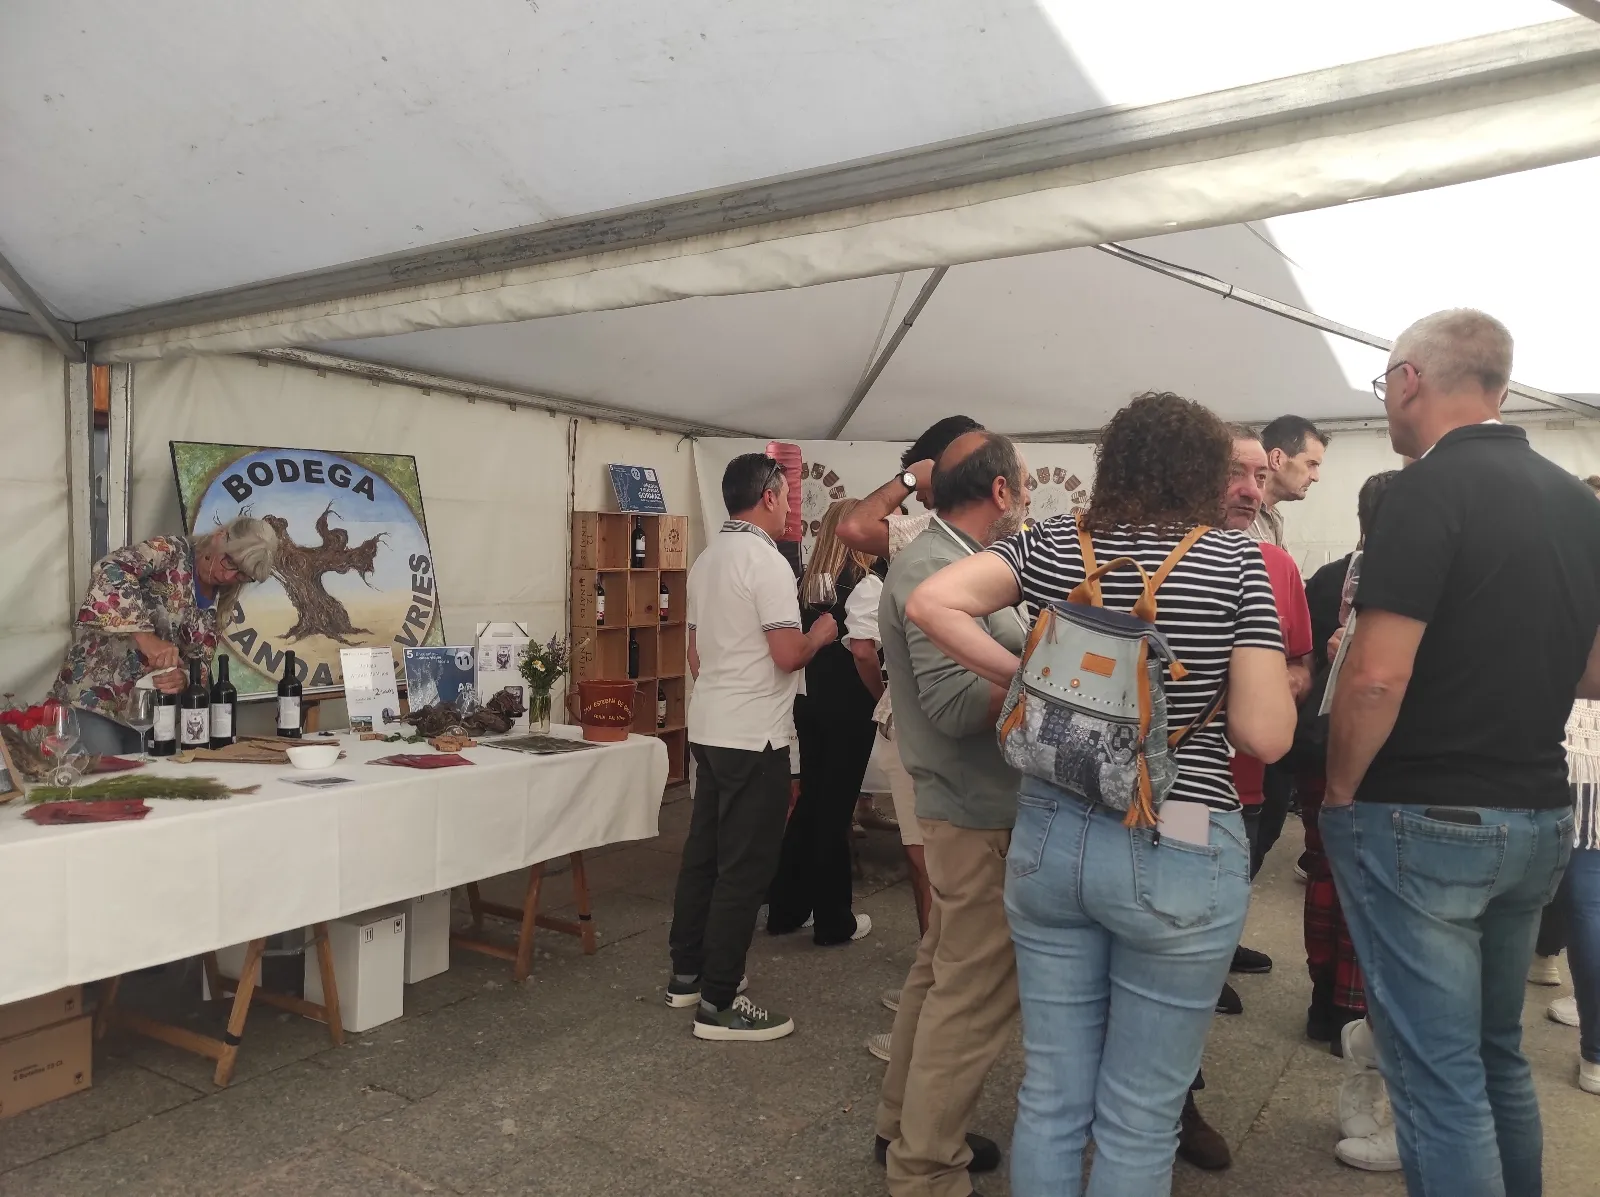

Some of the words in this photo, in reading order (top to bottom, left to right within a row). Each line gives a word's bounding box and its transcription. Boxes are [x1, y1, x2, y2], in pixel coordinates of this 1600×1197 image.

[222, 459, 375, 503] BODEGA
[586, 535, 593, 545] 12
[394, 553, 433, 647] VRIES
[586, 593, 593, 604] 12
[406, 650, 414, 659] 5
[586, 651, 593, 662] 12
[457, 655, 470, 666] 11
